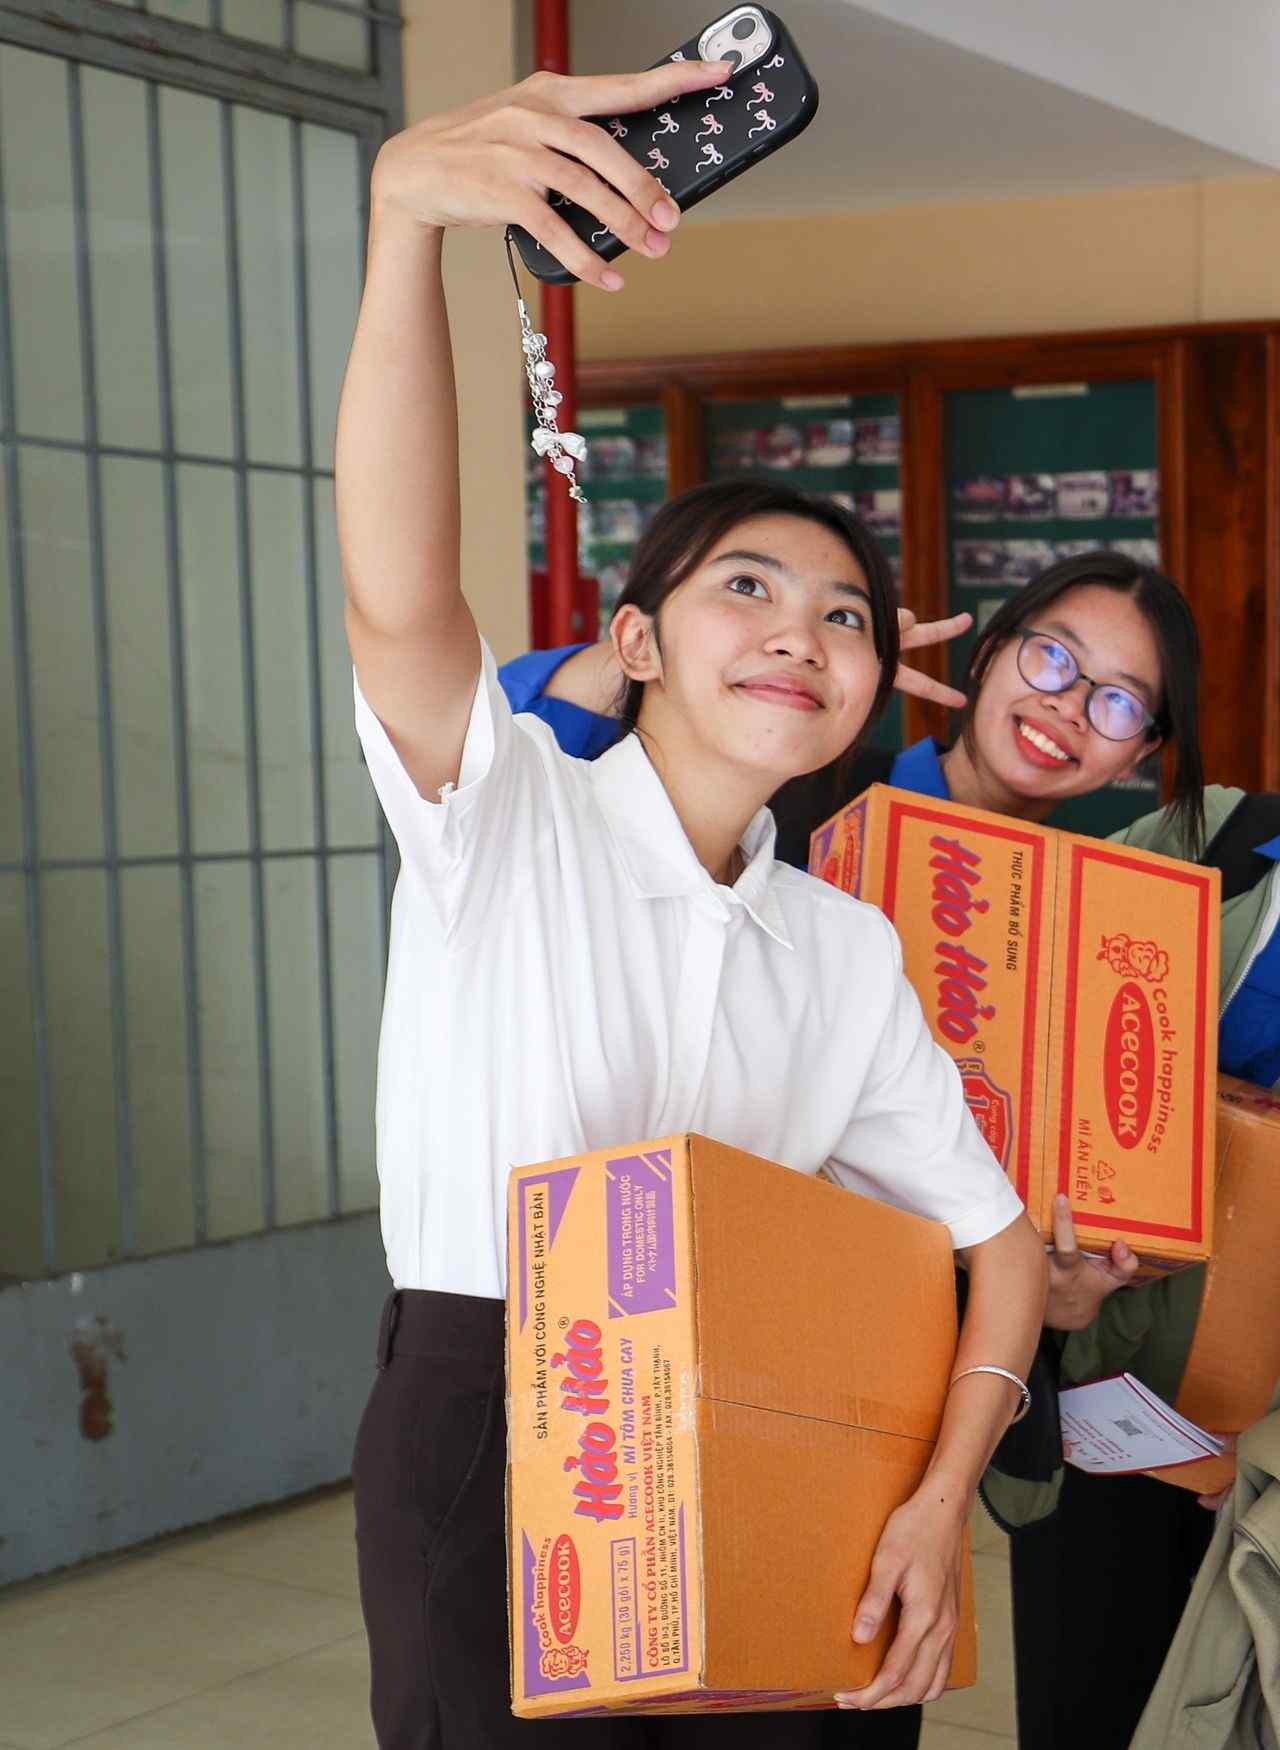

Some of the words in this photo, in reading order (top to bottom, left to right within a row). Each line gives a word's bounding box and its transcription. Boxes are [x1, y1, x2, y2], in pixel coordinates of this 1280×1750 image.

[1011, 851, 1023, 880] THỰC
[929, 835, 990, 937] Hảo
[1008, 884, 1025, 917] PHẨM
[1007, 922, 1023, 936] BỔ
[1006, 940, 1018, 971] SUNG
[933, 941, 996, 1044] Hảo
[1152, 988, 1176, 1041] Cook
[1147, 1051, 1178, 1154] happiness
[1079, 1118, 1091, 1136] MÌ
[634, 1185, 643, 1209] ONLY
[1076, 1165, 1092, 1201] LIỀN
[529, 1192, 544, 1218] BẢN
[531, 1224, 546, 1257] NHẬT
[621, 1208, 632, 1245] TRONG
[635, 1212, 644, 1260] DOMESTIC
[531, 1261, 547, 1298] NGHỆ
[636, 1263, 646, 1283] FOR
[533, 1303, 545, 1340] CÔNG
[533, 1344, 546, 1365] VỚI
[618, 1337, 632, 1363] CAY
[550, 1320, 609, 1416] Hảo
[532, 1370, 546, 1406] PHẨM
[621, 1368, 634, 1404] CHUA
[620, 1409, 635, 1440] TÔM
[641, 1395, 651, 1425] NAM
[534, 1412, 548, 1439] SẢN
[654, 1424, 663, 1439] TÂN
[642, 1430, 654, 1461] VIỆT
[654, 1441, 664, 1470] NGHIỆP
[563, 1422, 624, 1523] Hảo
[655, 1473, 664, 1494] CÔNG
[644, 1465, 654, 1532] ACECOOK
[656, 1496, 664, 1512] KHU
[658, 1526, 665, 1536] CN
[669, 1529, 678, 1545] VIỆT
[618, 1560, 628, 1573] 75
[641, 1536, 656, 1576] PHẦN
[534, 1536, 551, 1608] happiness
[657, 1580, 667, 1590] SỐ
[670, 1575, 678, 1588] CHÍ
[641, 1581, 657, 1601] CỔ
[618, 1606, 630, 1622] (30
[648, 1605, 657, 1624] TY
[535, 1614, 551, 1647] Cook
[621, 1627, 632, 1638] kg
[646, 1627, 658, 1667] CÔNG
